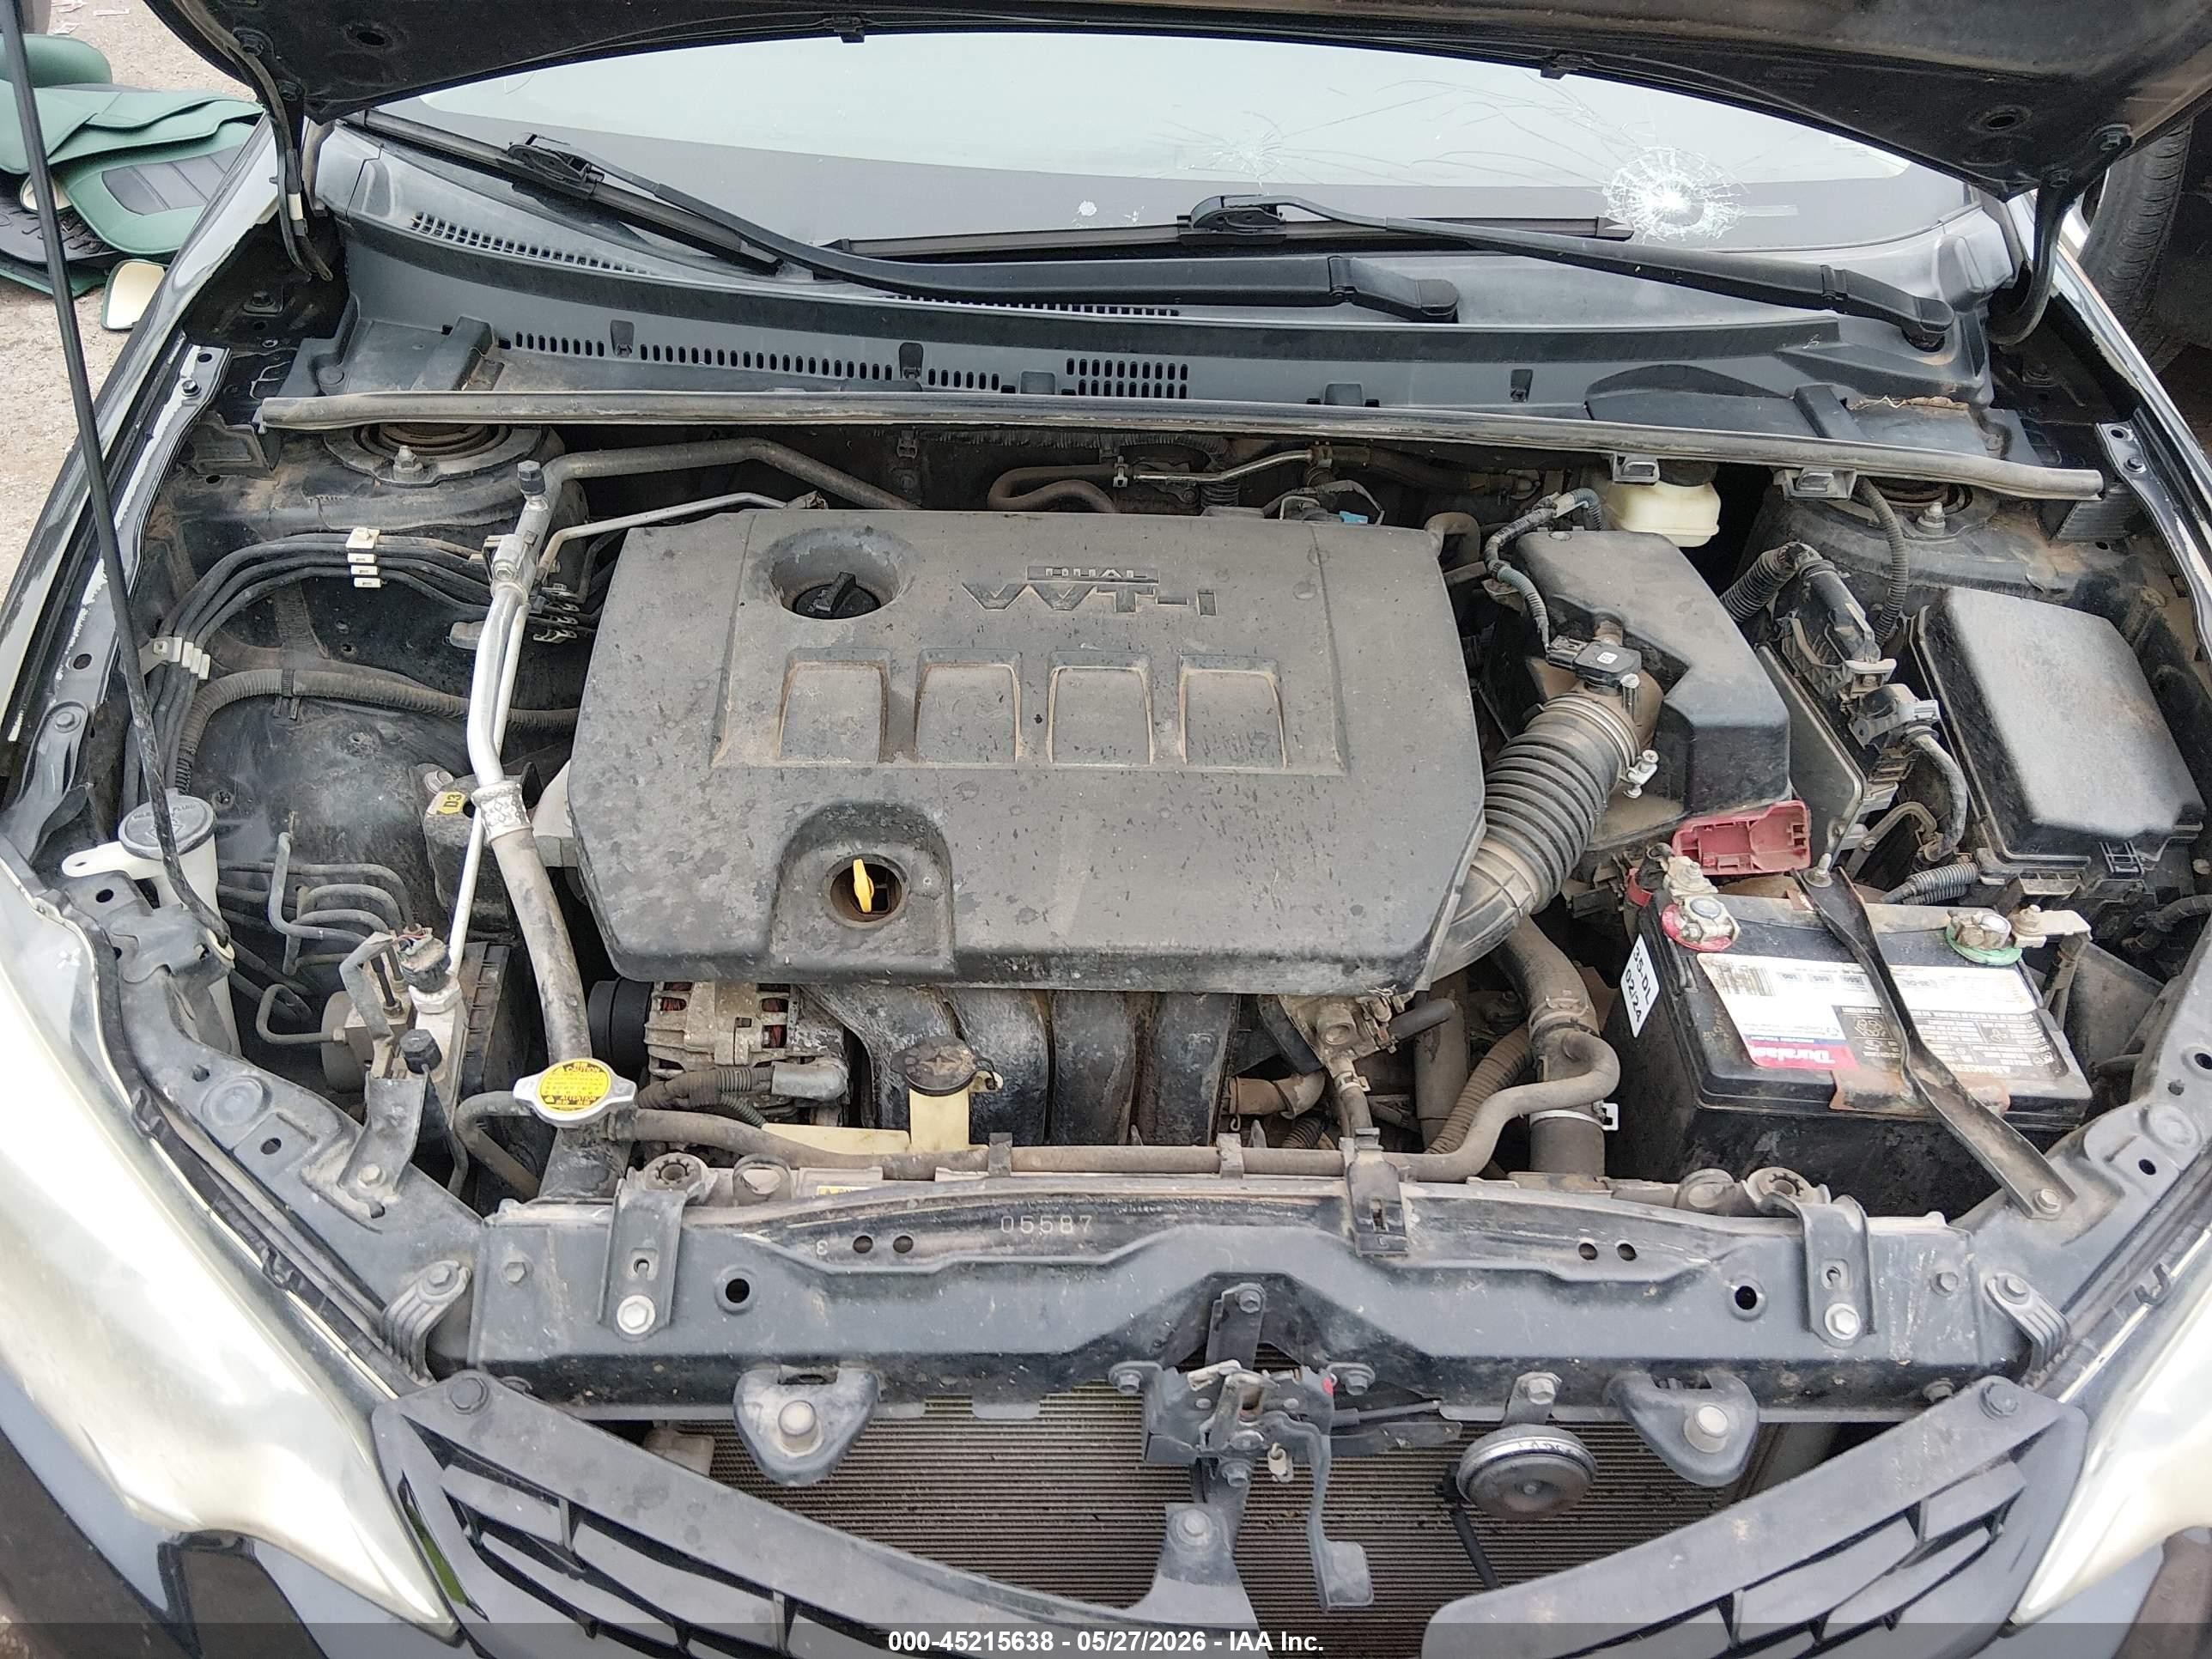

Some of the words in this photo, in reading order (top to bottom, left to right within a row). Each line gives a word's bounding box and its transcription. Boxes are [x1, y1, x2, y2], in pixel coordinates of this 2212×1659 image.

[1045, 567, 1148, 578] DUAL
[442, 793, 462, 808] D3
[1633, 946, 1651, 1006] 35-DL
[1626, 968, 1642, 1023] 02/24
[1000, 1215, 1094, 1236] 05587
